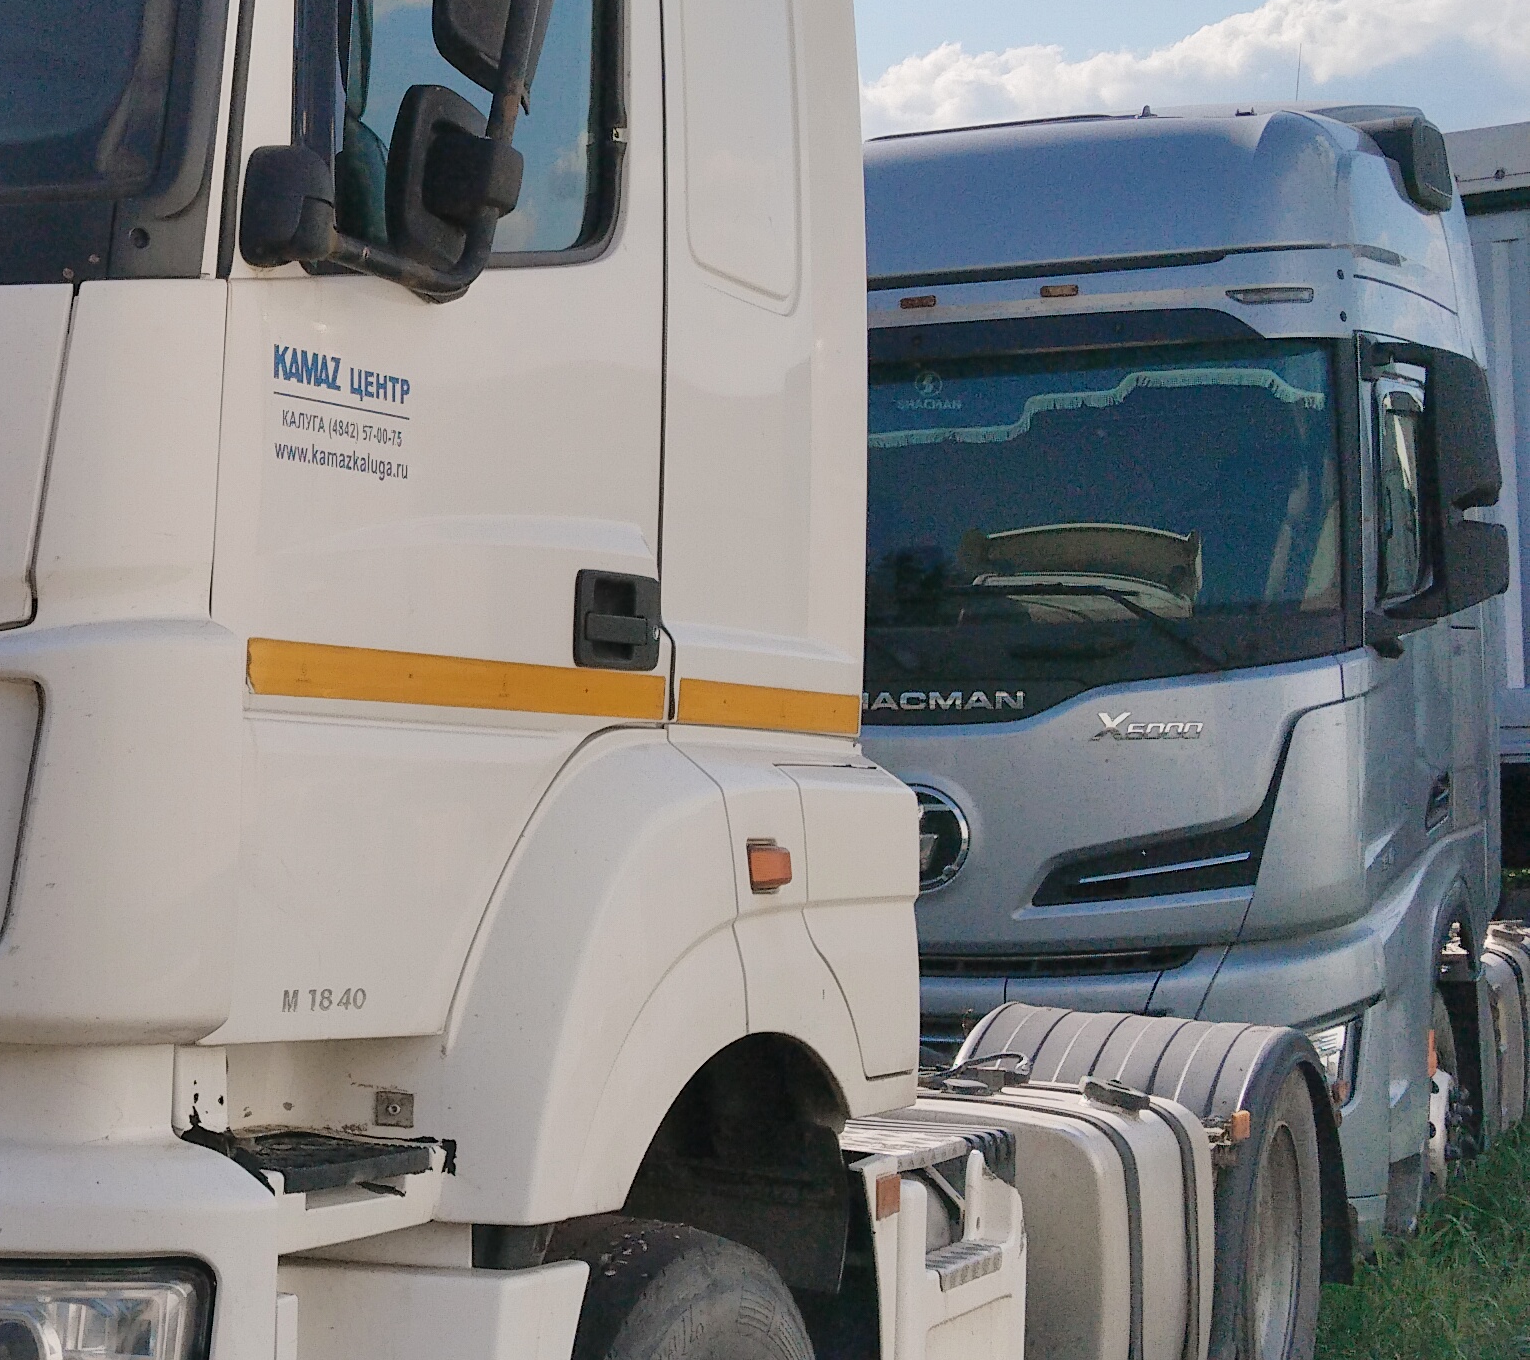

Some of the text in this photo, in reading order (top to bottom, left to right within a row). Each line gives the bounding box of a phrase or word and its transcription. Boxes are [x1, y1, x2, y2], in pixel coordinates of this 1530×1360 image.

[273, 343, 411, 404] KAMAZ ЦЕНТР
[282, 409, 403, 448] КАЛУГА (4842) 57-00-75
[274, 442, 409, 482] www.kamazkaluga.ru
